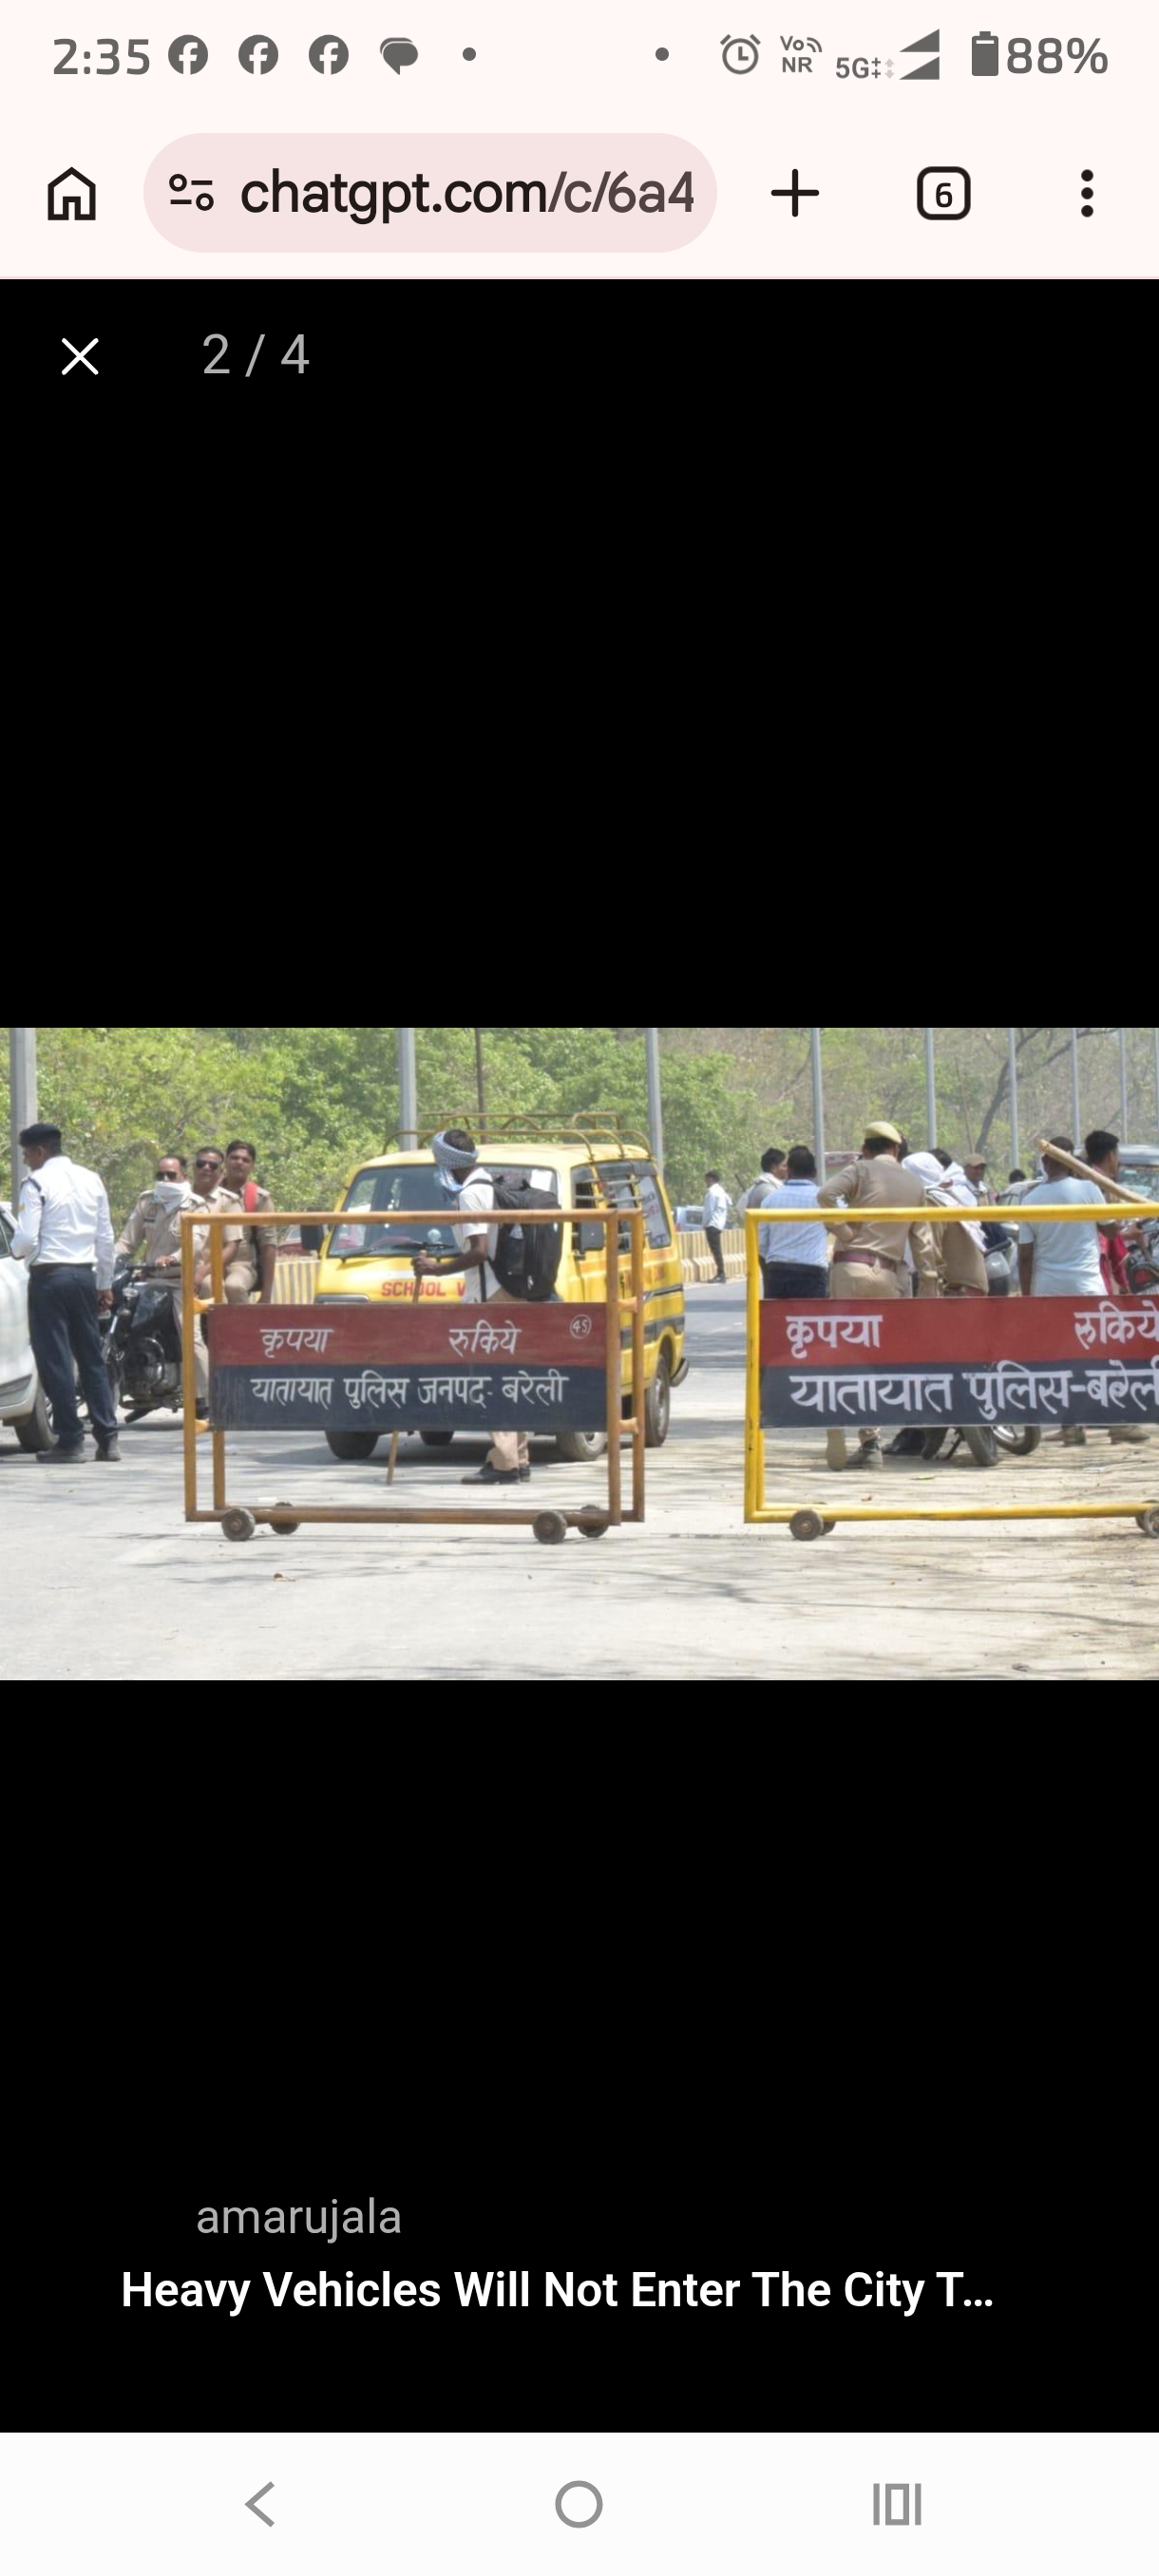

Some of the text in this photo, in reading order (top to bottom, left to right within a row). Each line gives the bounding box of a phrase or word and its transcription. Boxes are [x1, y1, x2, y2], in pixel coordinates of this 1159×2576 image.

[54, 39, 150, 76] 2:35
[780, 35, 805, 51] Vo
[1007, 38, 1109, 75] 88%
[782, 56, 813, 73] NR
[240, 168, 694, 225] chatgpt.com/c/6a4
[935, 182, 953, 208] 6
[202, 333, 231, 374] 2
[280, 333, 311, 374] 4
[259, 1328, 334, 1358] कृपया
[786, 1315, 884, 1359] कृपया
[251, 1378, 334, 1410] यातायात
[343, 1370, 410, 1410] पुलिस
[502, 1368, 570, 1406] बरेली
[788, 1373, 954, 1414] यातायात
[197, 2196, 402, 2245] amarujala
[123, 2271, 252, 2318] Heavy
[261, 2270, 441, 2307] Vehicles
[453, 2270, 529, 2307] Will
[544, 2271, 618, 2307] Not
[632, 2271, 741, 2307] Enter
[750, 2270, 831, 2307] The
[844, 2270, 926, 2318] City
